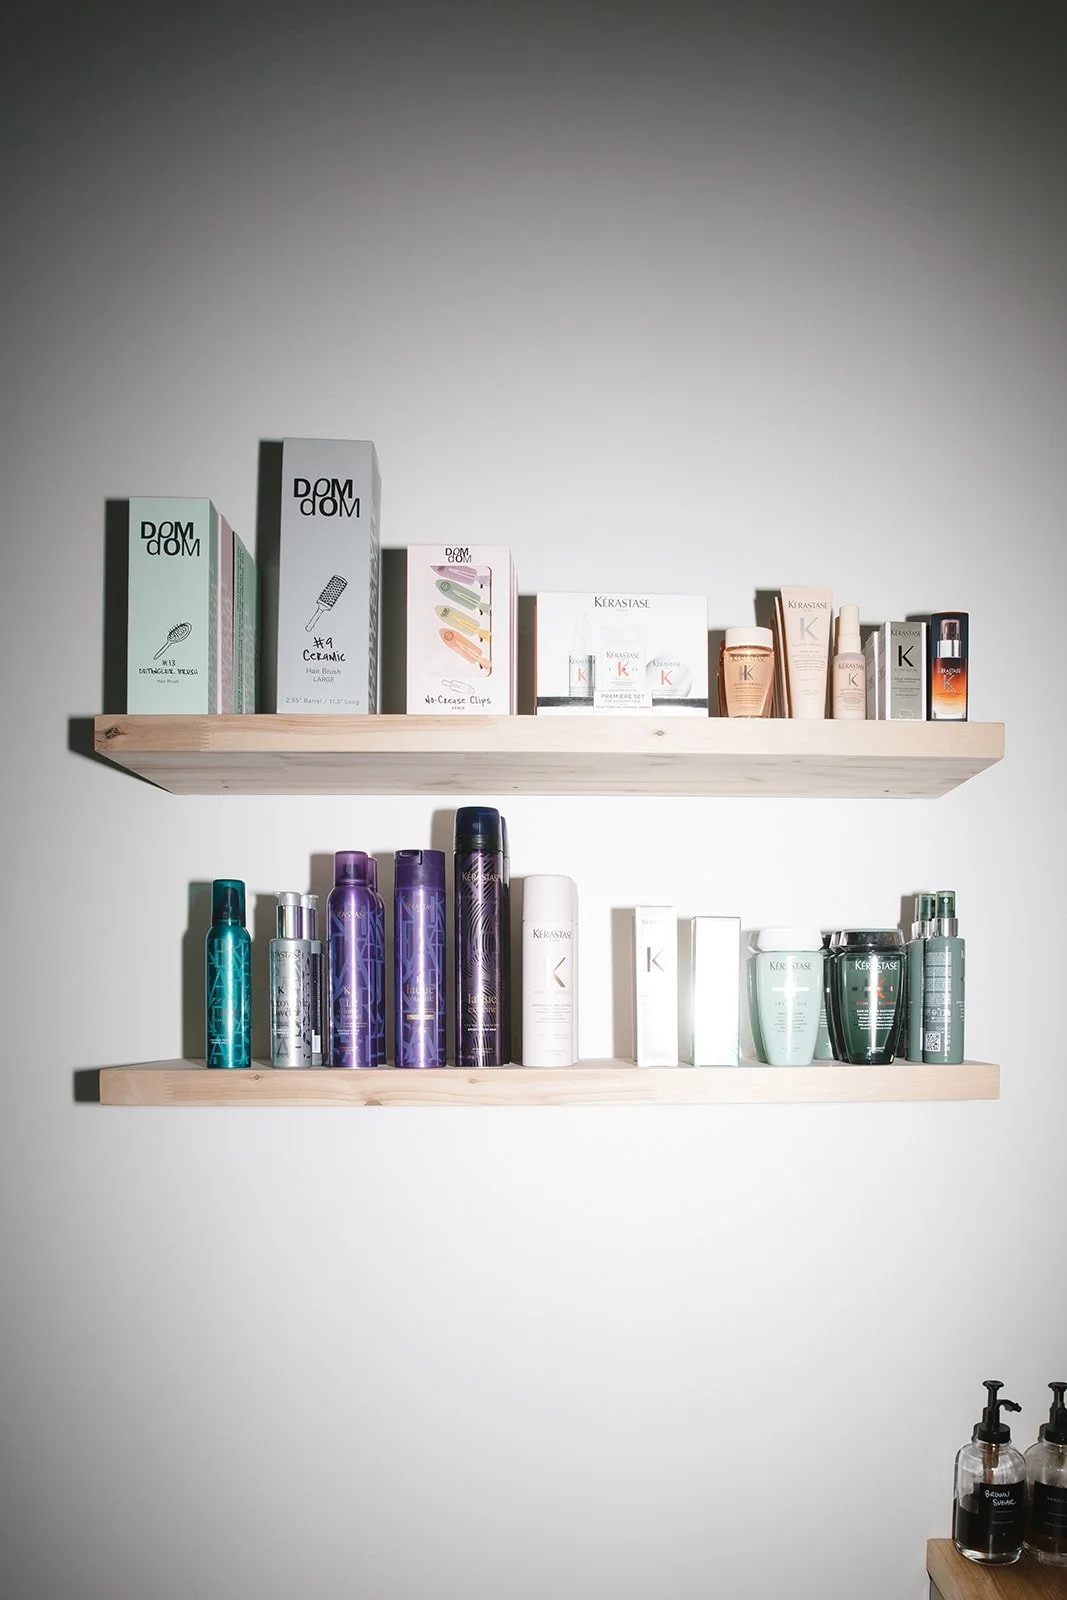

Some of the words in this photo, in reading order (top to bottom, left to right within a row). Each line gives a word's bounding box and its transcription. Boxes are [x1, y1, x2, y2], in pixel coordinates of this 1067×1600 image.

[294, 478, 353, 499] DOM
[141, 521, 194, 539] DOM
[445, 547, 469, 556] DOM
[594, 595, 650, 608] KÉRASTASE
[800, 616, 819, 640] K
[313, 636, 333, 649] #9
[898, 645, 914, 667] K
[578, 668, 587, 682] K
[618, 661, 629, 676] K
[661, 669, 673, 686] K
[848, 672, 859, 687] K
[646, 944, 669, 973] K
[769, 960, 812, 971] KÉRSTASE
[855, 960, 898, 971] KÉRSTASE
[467, 993, 498, 1005] laue
